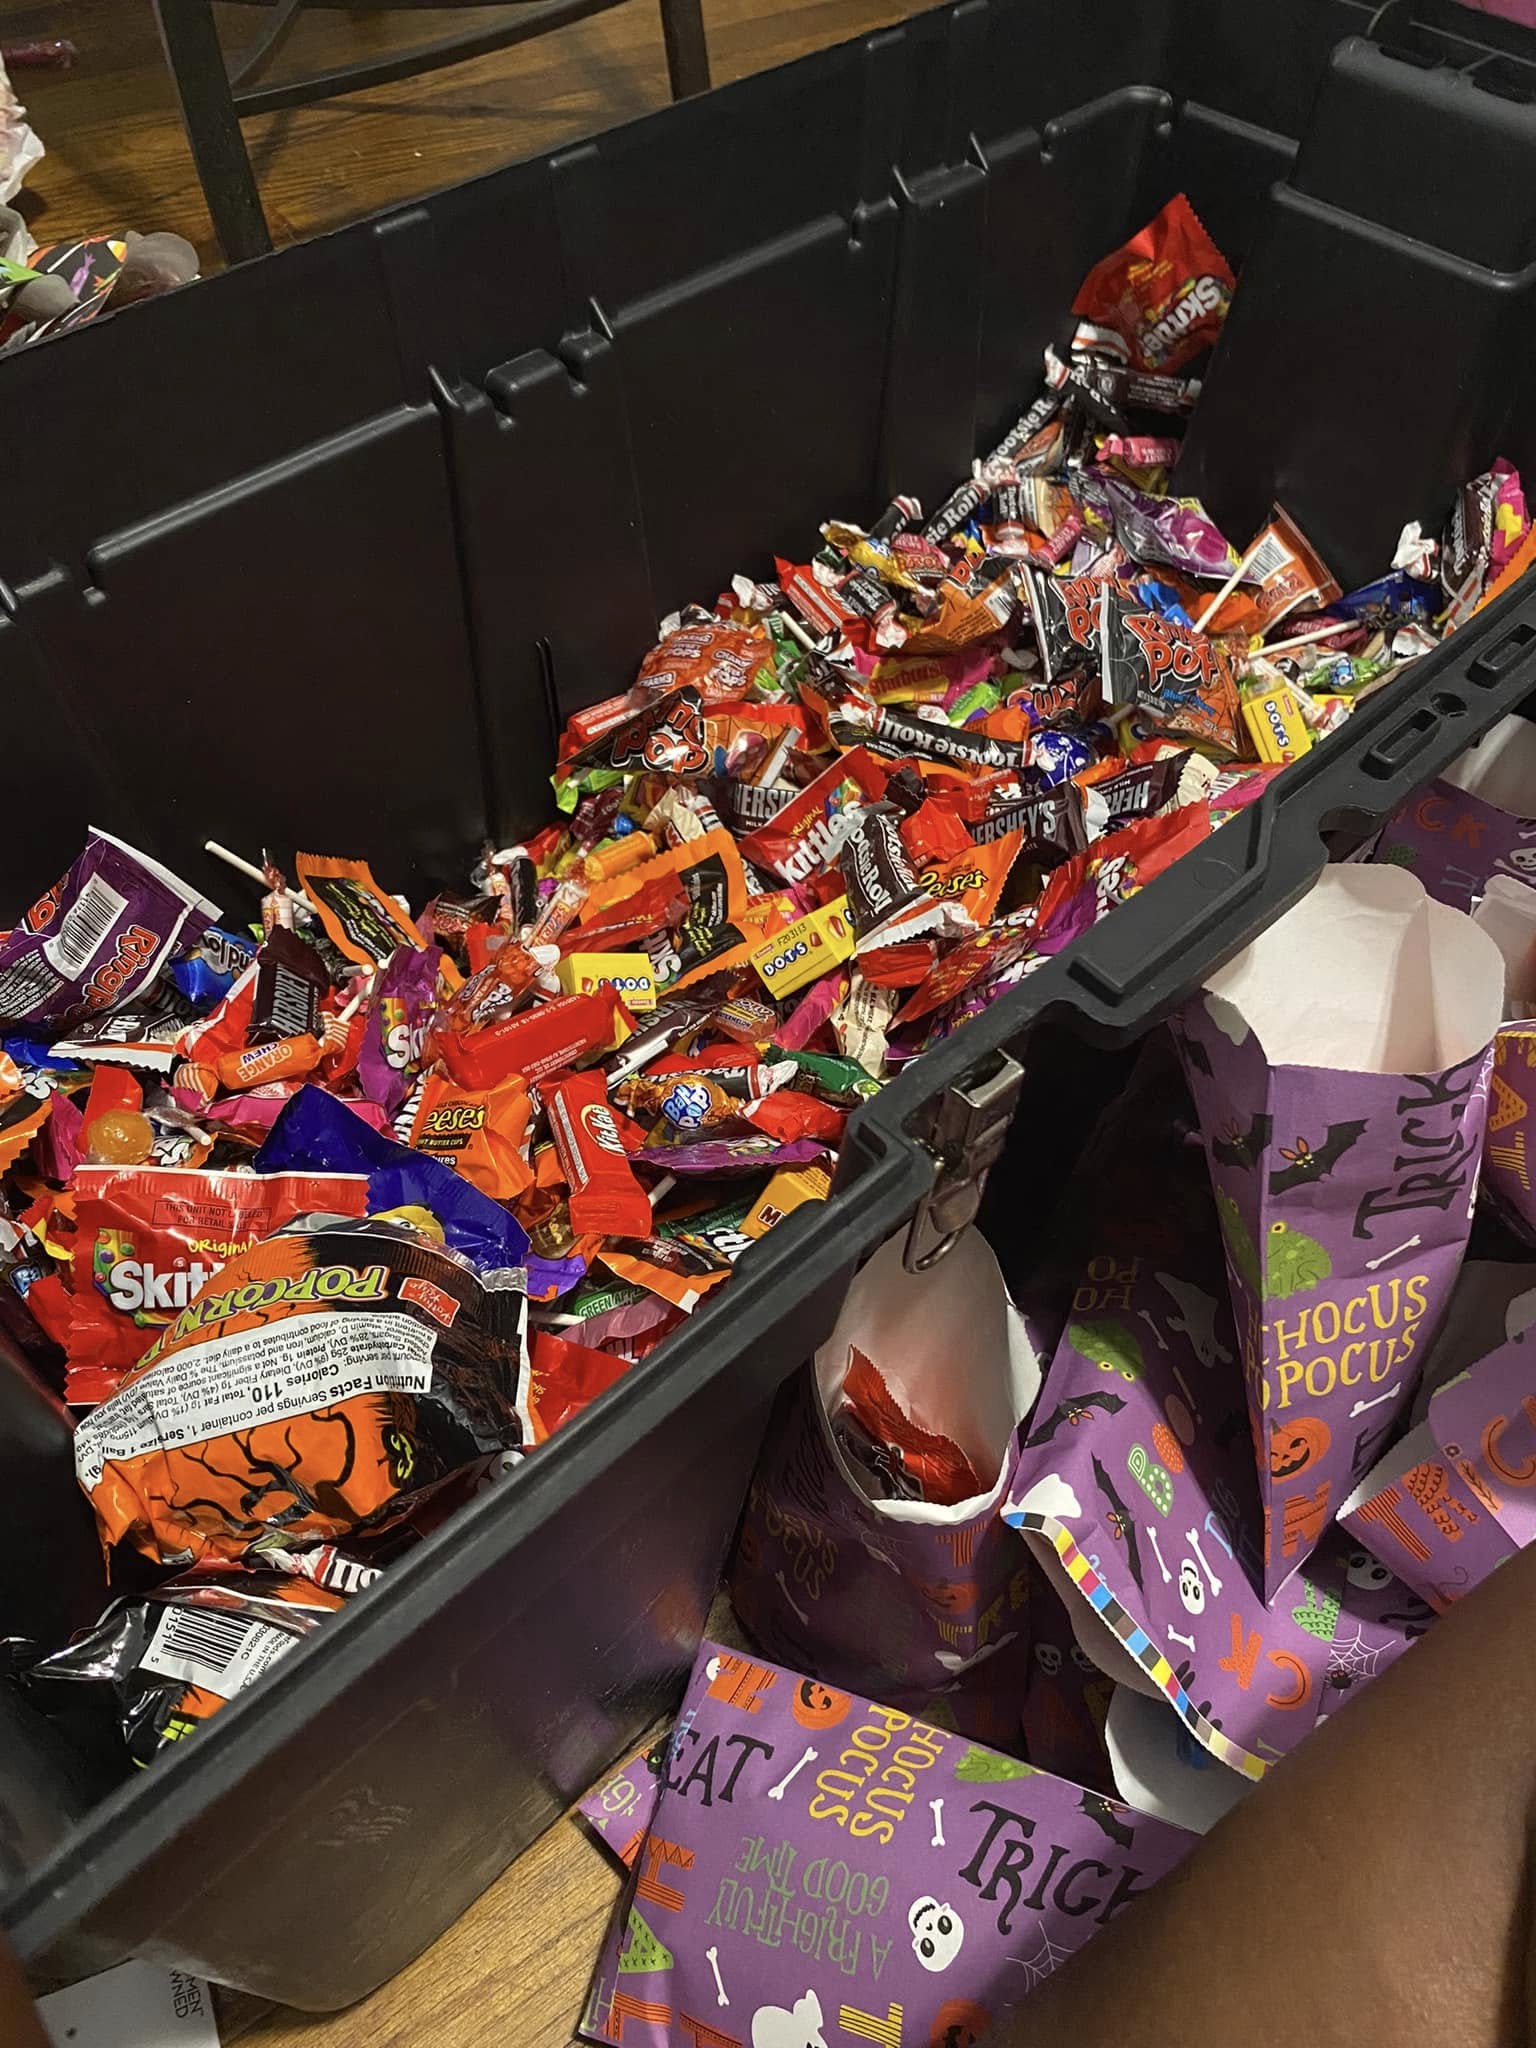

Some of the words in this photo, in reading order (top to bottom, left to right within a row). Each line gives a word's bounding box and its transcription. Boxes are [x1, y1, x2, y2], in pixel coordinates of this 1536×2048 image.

[1263, 699, 1290, 748] DOTS
[762, 941, 808, 977] DOTS
[234, 1043, 294, 1082] ORANGE
[240, 1041, 280, 1066] CHEW
[422, 1104, 486, 1132] eese's
[309, 1320, 330, 1333] food
[1272, 1273, 1430, 1362] HOCUS
[262, 1327, 310, 1348] contributes
[286, 1339, 304, 1350] iron
[220, 1344, 244, 1359] daily
[267, 1344, 285, 1356] and
[295, 1342, 327, 1359] Protein
[330, 1346, 349, 1359] 25g
[200, 1364, 218, 1375] The
[261, 1357, 278, 1369] Not
[343, 1353, 379, 1367] serving:
[1275, 1320, 1422, 1410] POCUS
[164, 1371, 188, 1386] Daily
[207, 1362, 253, 1384] significant
[234, 1373, 258, 1387] Fiber
[259, 1364, 292, 1381] Dietary
[285, 1363, 340, 1388] Calories
[177, 1376, 207, 1391] source
[247, 1379, 284, 1404] 110,
[329, 1375, 372, 1398] Facts
[375, 1376, 424, 1389] Nutrition
[203, 1396, 220, 1408] Fat
[221, 1389, 245, 1403] Total
[277, 1390, 327, 1411] Servings
[256, 1402, 275, 1417] per
[199, 1410, 254, 1434] container
[808, 1704, 916, 1826] POCUS
[850, 1720, 953, 1846] HOCUS
[801, 1855, 891, 1918] GOOD
